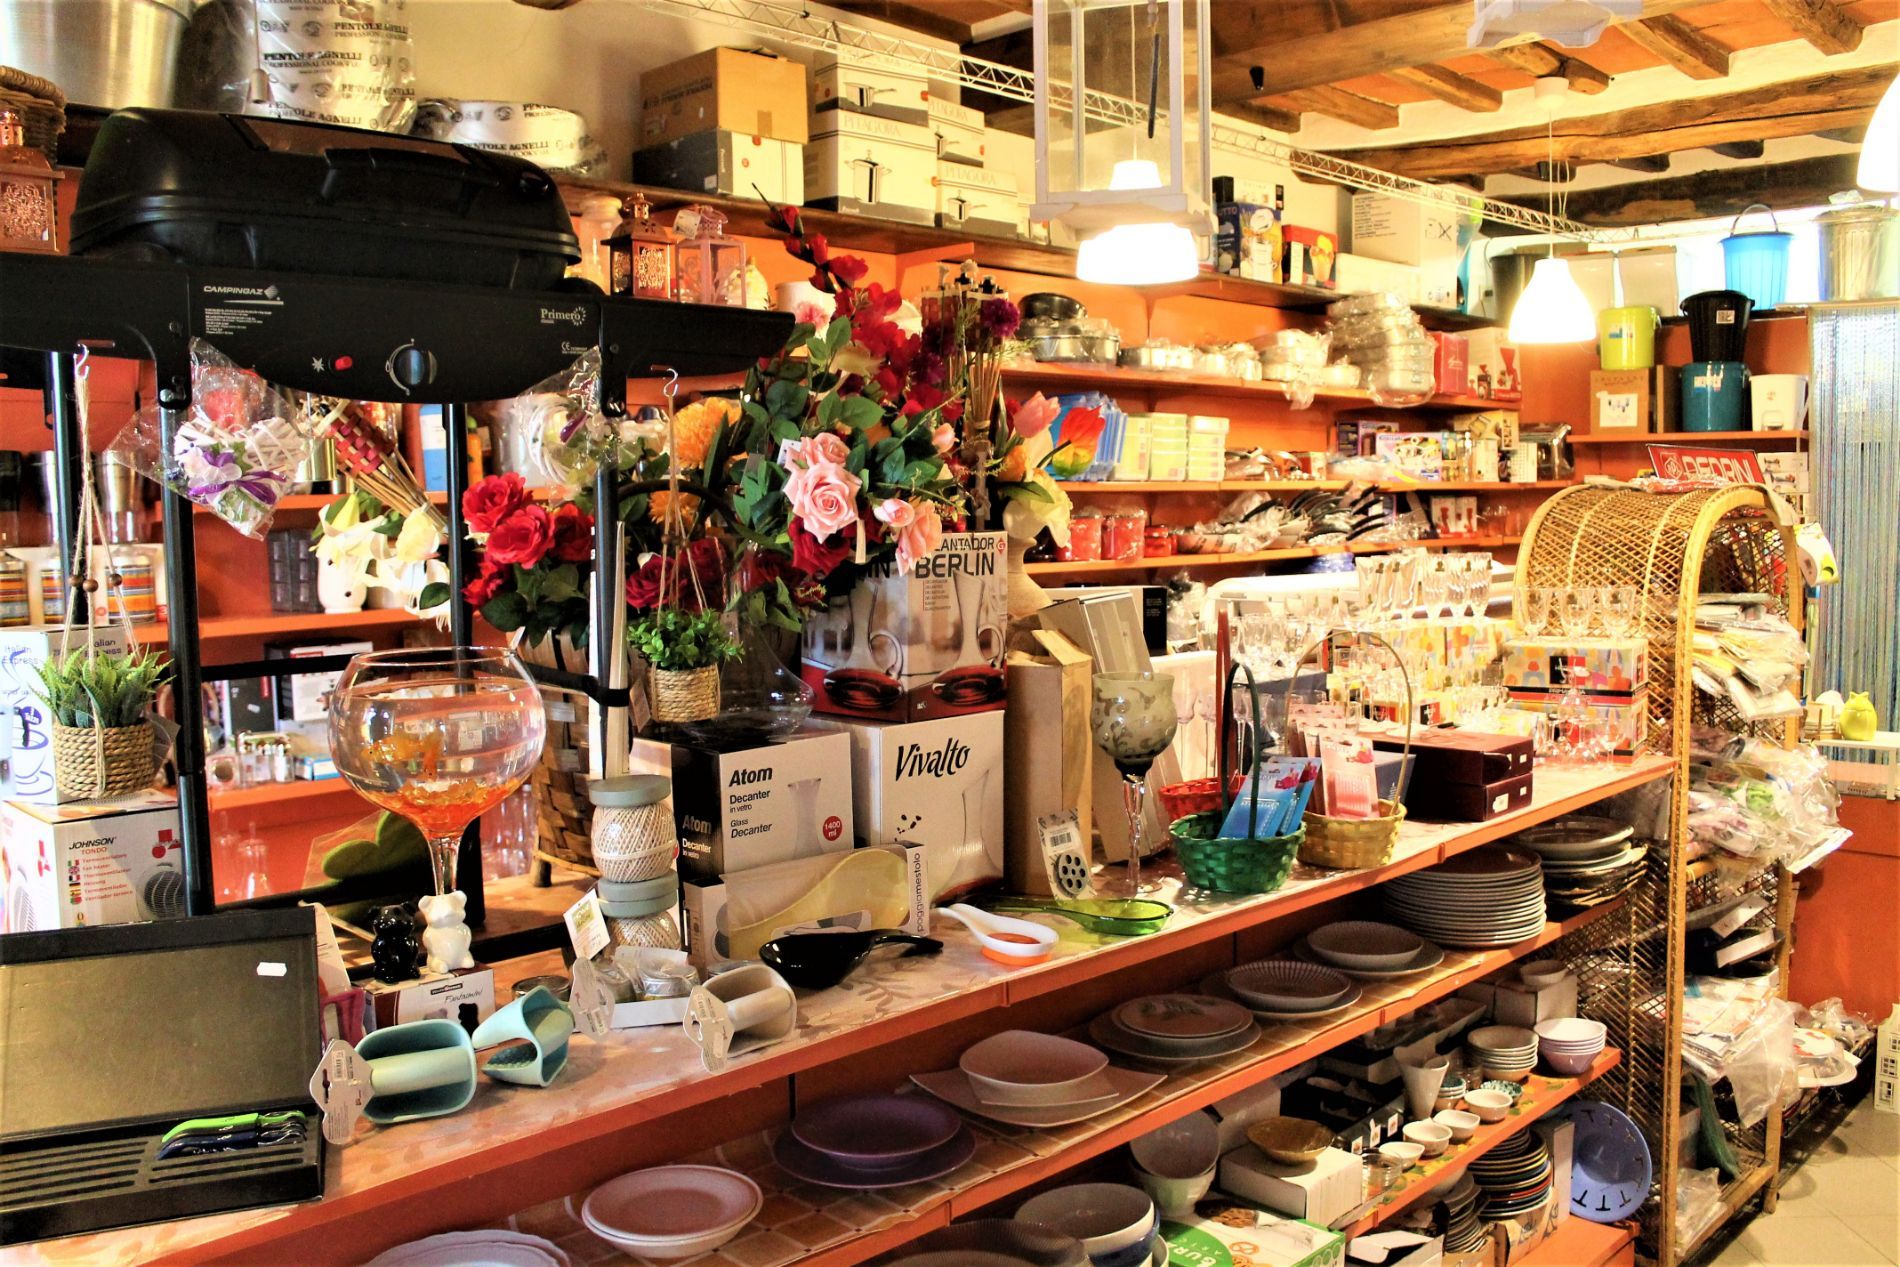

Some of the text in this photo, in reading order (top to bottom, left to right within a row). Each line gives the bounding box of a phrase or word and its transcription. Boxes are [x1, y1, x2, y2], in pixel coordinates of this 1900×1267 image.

[203, 285, 264, 296] CAMPINGAZ
[541, 308, 581, 321] Primero
[915, 552, 995, 580] BERLIN
[895, 737, 971, 782] Vivalto
[728, 767, 773, 787] Atom
[729, 789, 771, 805] Decanter
[730, 803, 753, 813] in vetro
[682, 814, 712, 835] Atom
[730, 818, 749, 828] Glass
[825, 820, 841, 830] 1400
[731, 823, 773, 839] Decanter
[69, 837, 114, 850] JOHNSON
[82, 846, 108, 855] TONDO
[682, 837, 711, 853] Decanter
